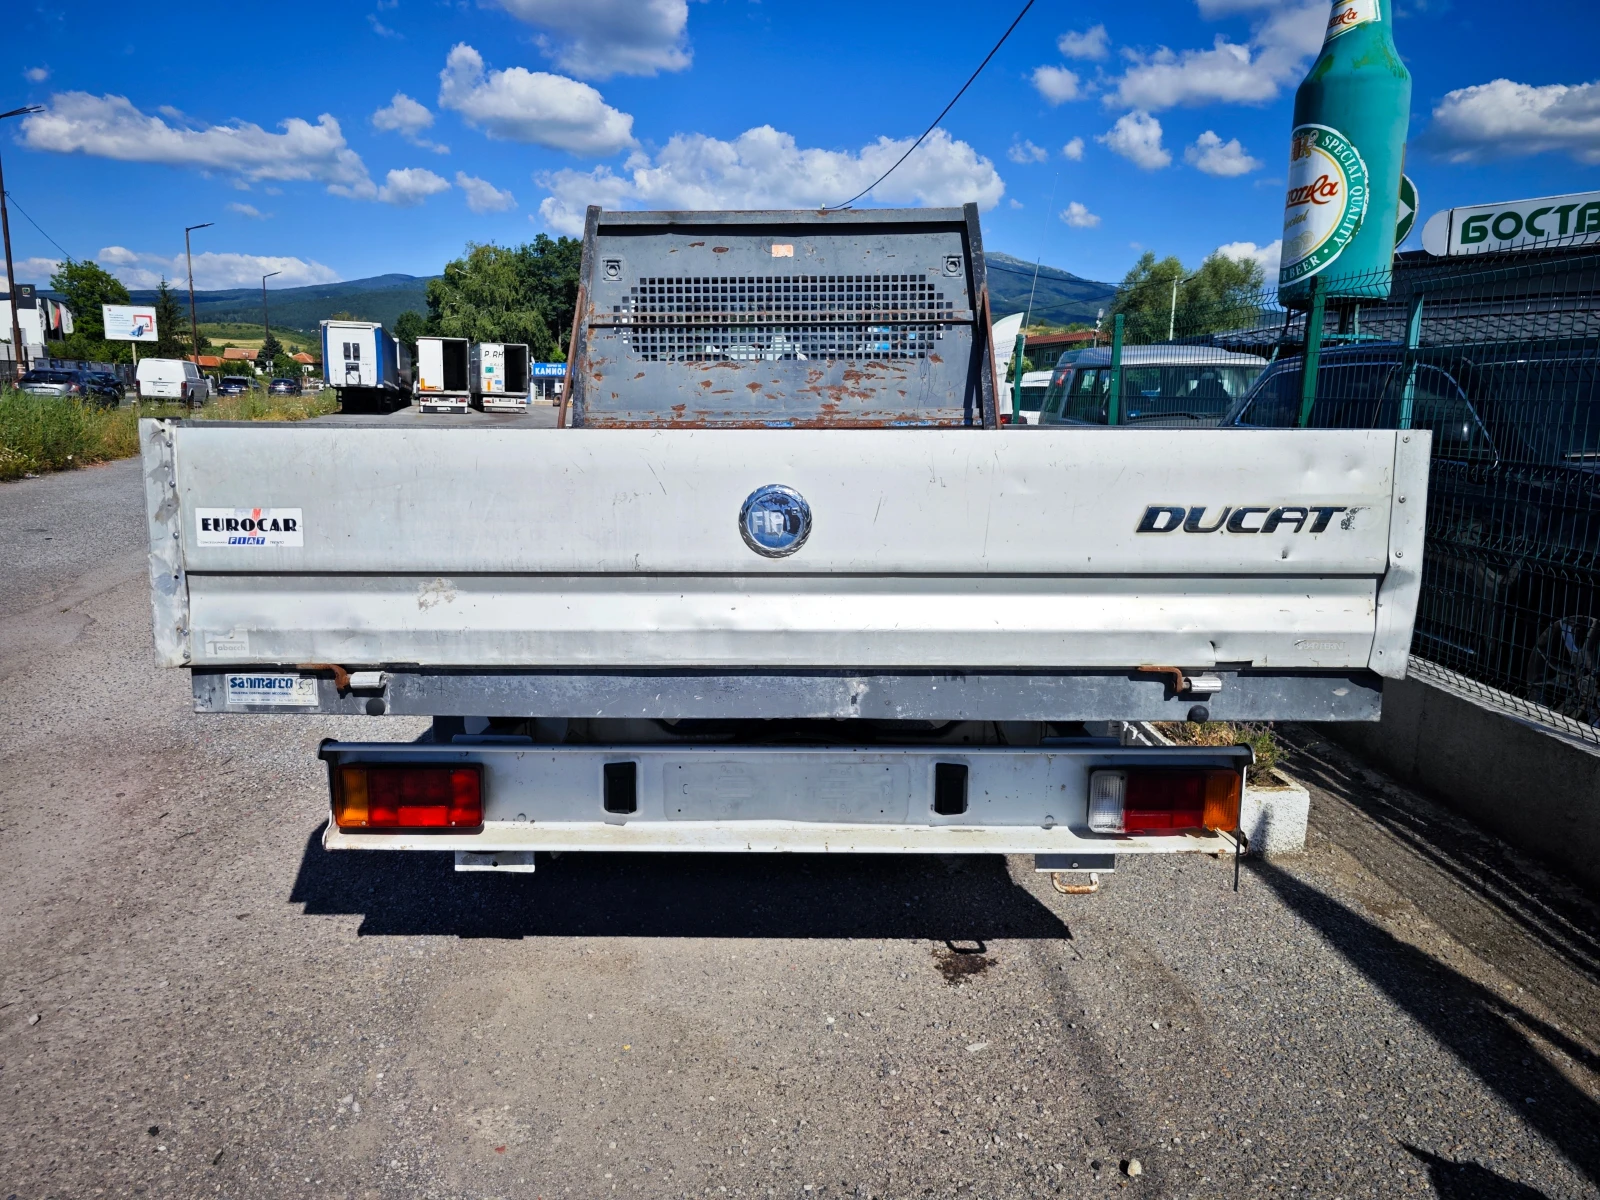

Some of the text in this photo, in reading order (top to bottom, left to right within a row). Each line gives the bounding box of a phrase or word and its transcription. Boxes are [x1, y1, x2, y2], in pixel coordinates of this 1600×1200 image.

[1322, 135, 1363, 247] SPECIAL QUALITY
[1461, 201, 1600, 245] БОСТВ
[1289, 255, 1321, 277] BEER
[535, 367, 573, 376] КАМИОН
[202, 518, 297, 532] EUROCAR
[228, 537, 265, 545] FIAT
[229, 677, 293, 689] sanmarco
